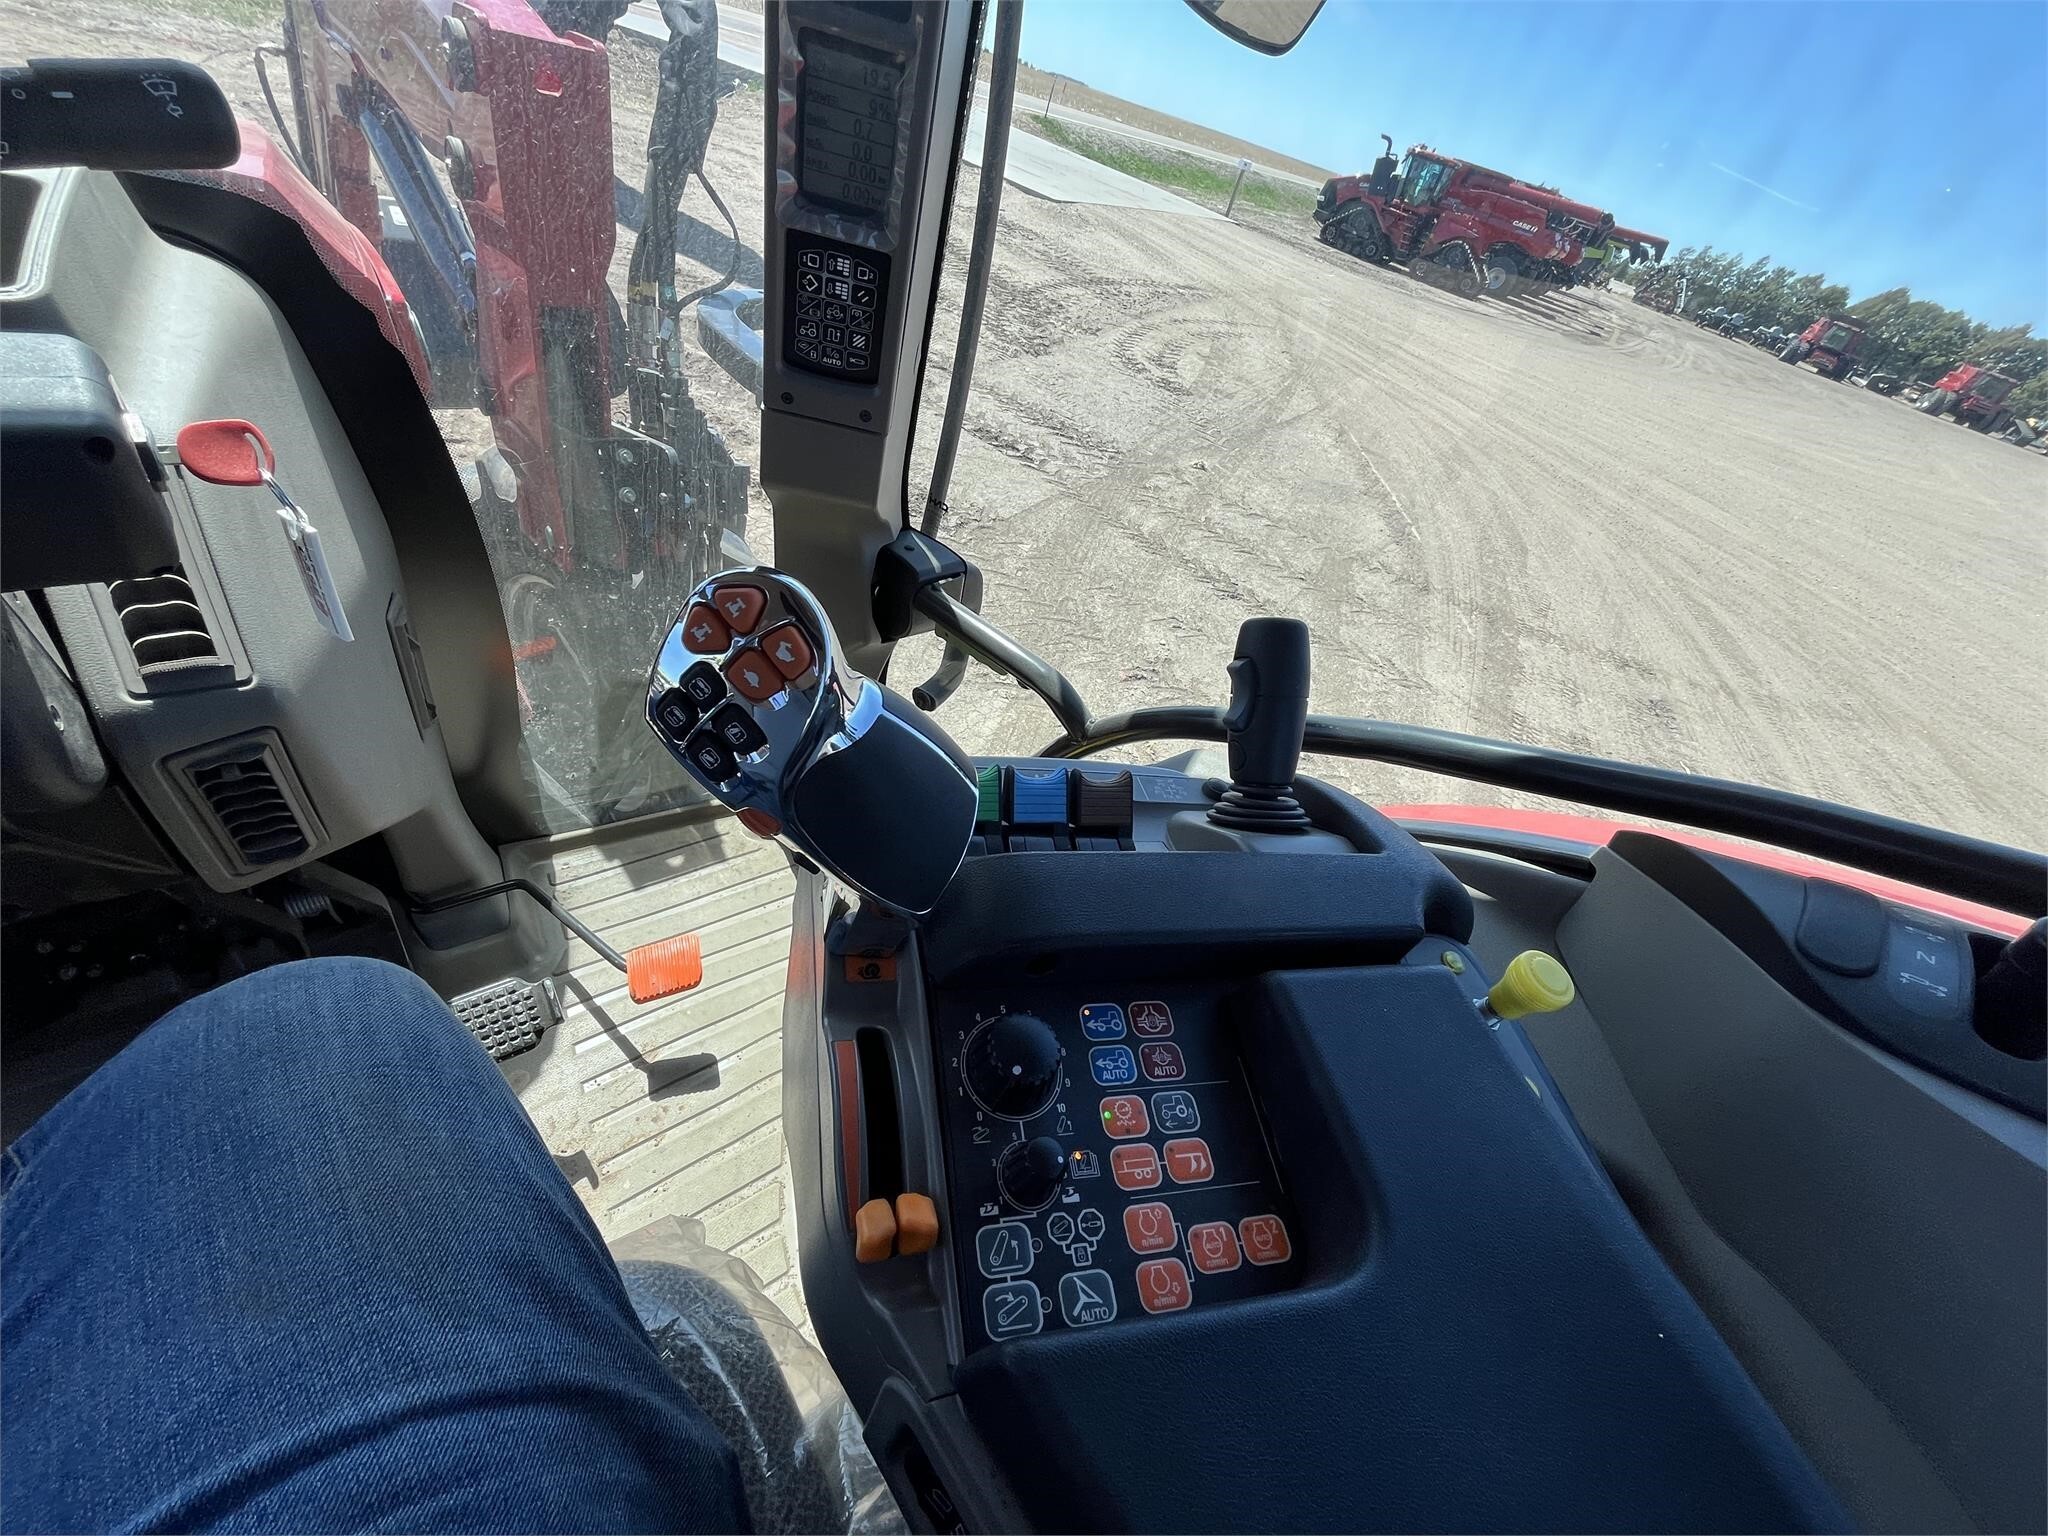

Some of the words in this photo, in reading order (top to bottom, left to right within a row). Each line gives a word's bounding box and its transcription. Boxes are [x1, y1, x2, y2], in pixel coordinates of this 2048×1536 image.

[854, 118, 874, 140] 0.7
[851, 141, 873, 163] 0.0
[847, 160, 877, 183] 0.00
[1512, 220, 1531, 231] CASE
[822, 355, 842, 367] AUTO
[999, 1004, 1007, 1014] 5
[975, 1012, 982, 1022] 4
[958, 1030, 966, 1040] 3
[951, 1057, 959, 1068] 2
[1102, 1069, 1129, 1081] AUTO
[1154, 1065, 1178, 1077] AUTO
[1064, 1077, 1071, 1088] 9
[957, 1086, 964, 1097] 1
[1056, 1103, 1067, 1114] 10
[976, 1110, 983, 1122] 0
[1269, 1219, 1279, 1234] 2
[1219, 1226, 1228, 1242] 1
[1141, 1235, 1165, 1248] n/min
[1206, 1257, 1230, 1268] n/min
[1153, 1295, 1178, 1307] n/min
[1080, 1305, 1110, 1324] AUTO
